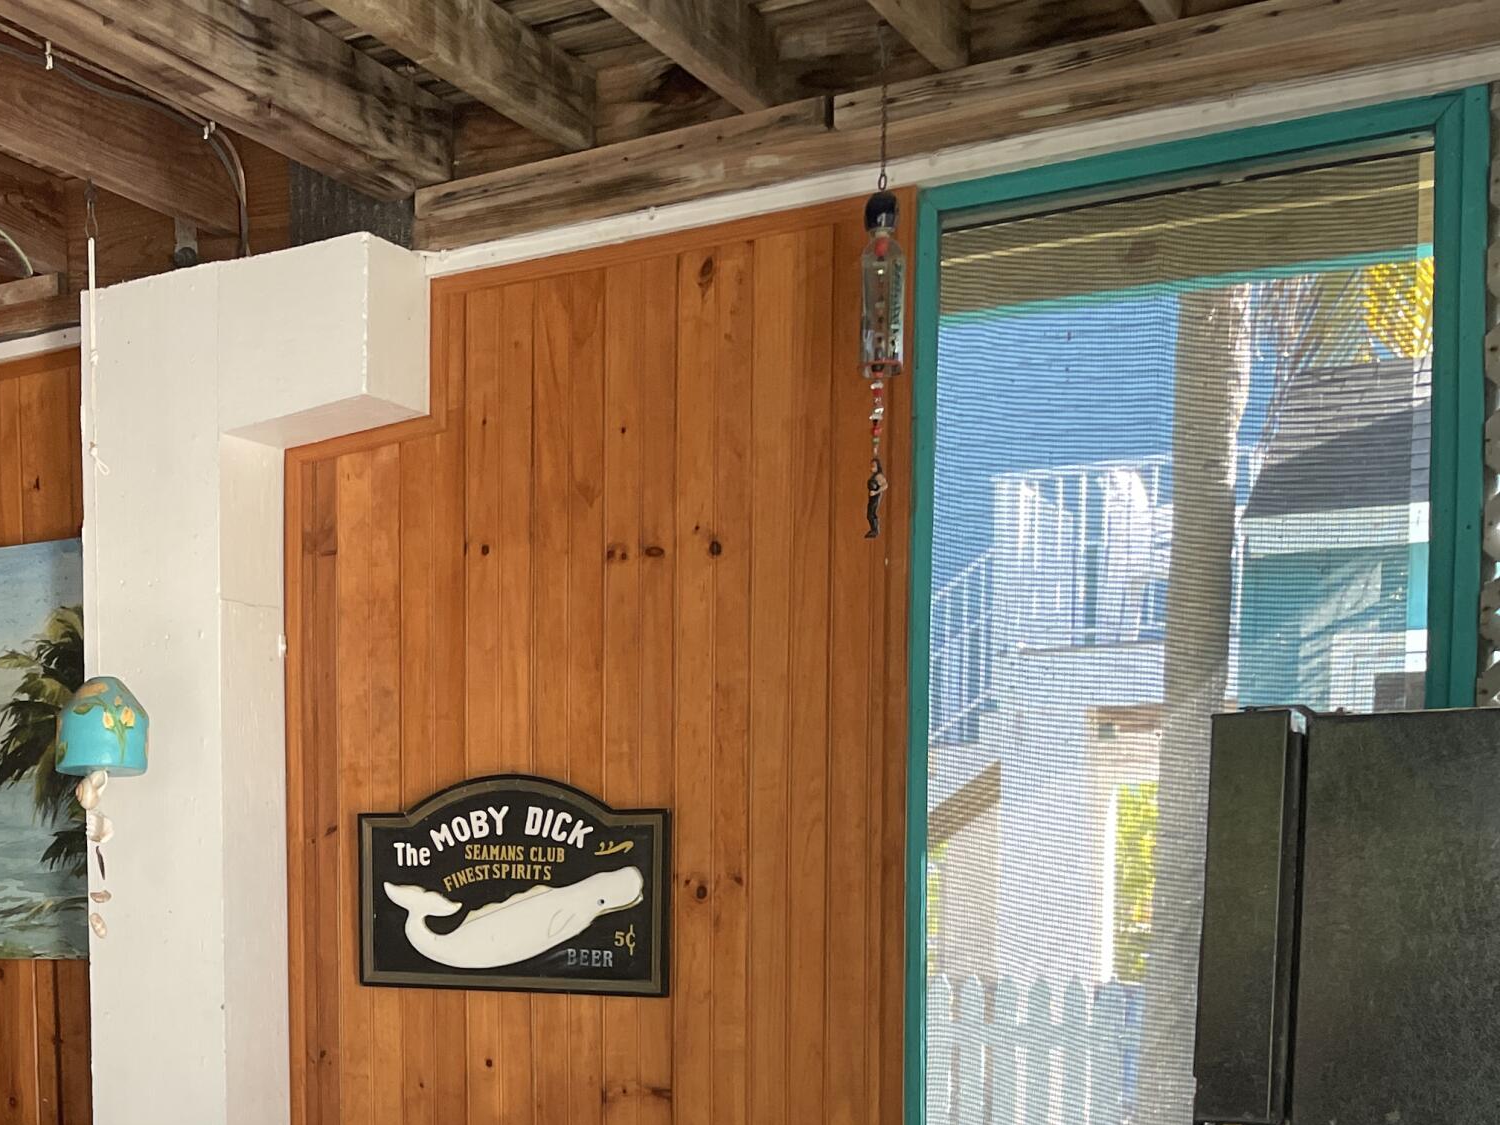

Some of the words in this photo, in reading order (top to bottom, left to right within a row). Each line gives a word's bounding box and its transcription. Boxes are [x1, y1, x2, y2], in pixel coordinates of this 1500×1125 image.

[394, 842, 431, 867] The
[429, 805, 510, 852] MOBY
[524, 805, 595, 849] DICK
[464, 844, 524, 862] SEAMANS
[529, 847, 566, 863] CLUB
[443, 865, 492, 893] FINEST
[492, 864, 553, 881] SPIRITS
[567, 948, 614, 968] BEER
